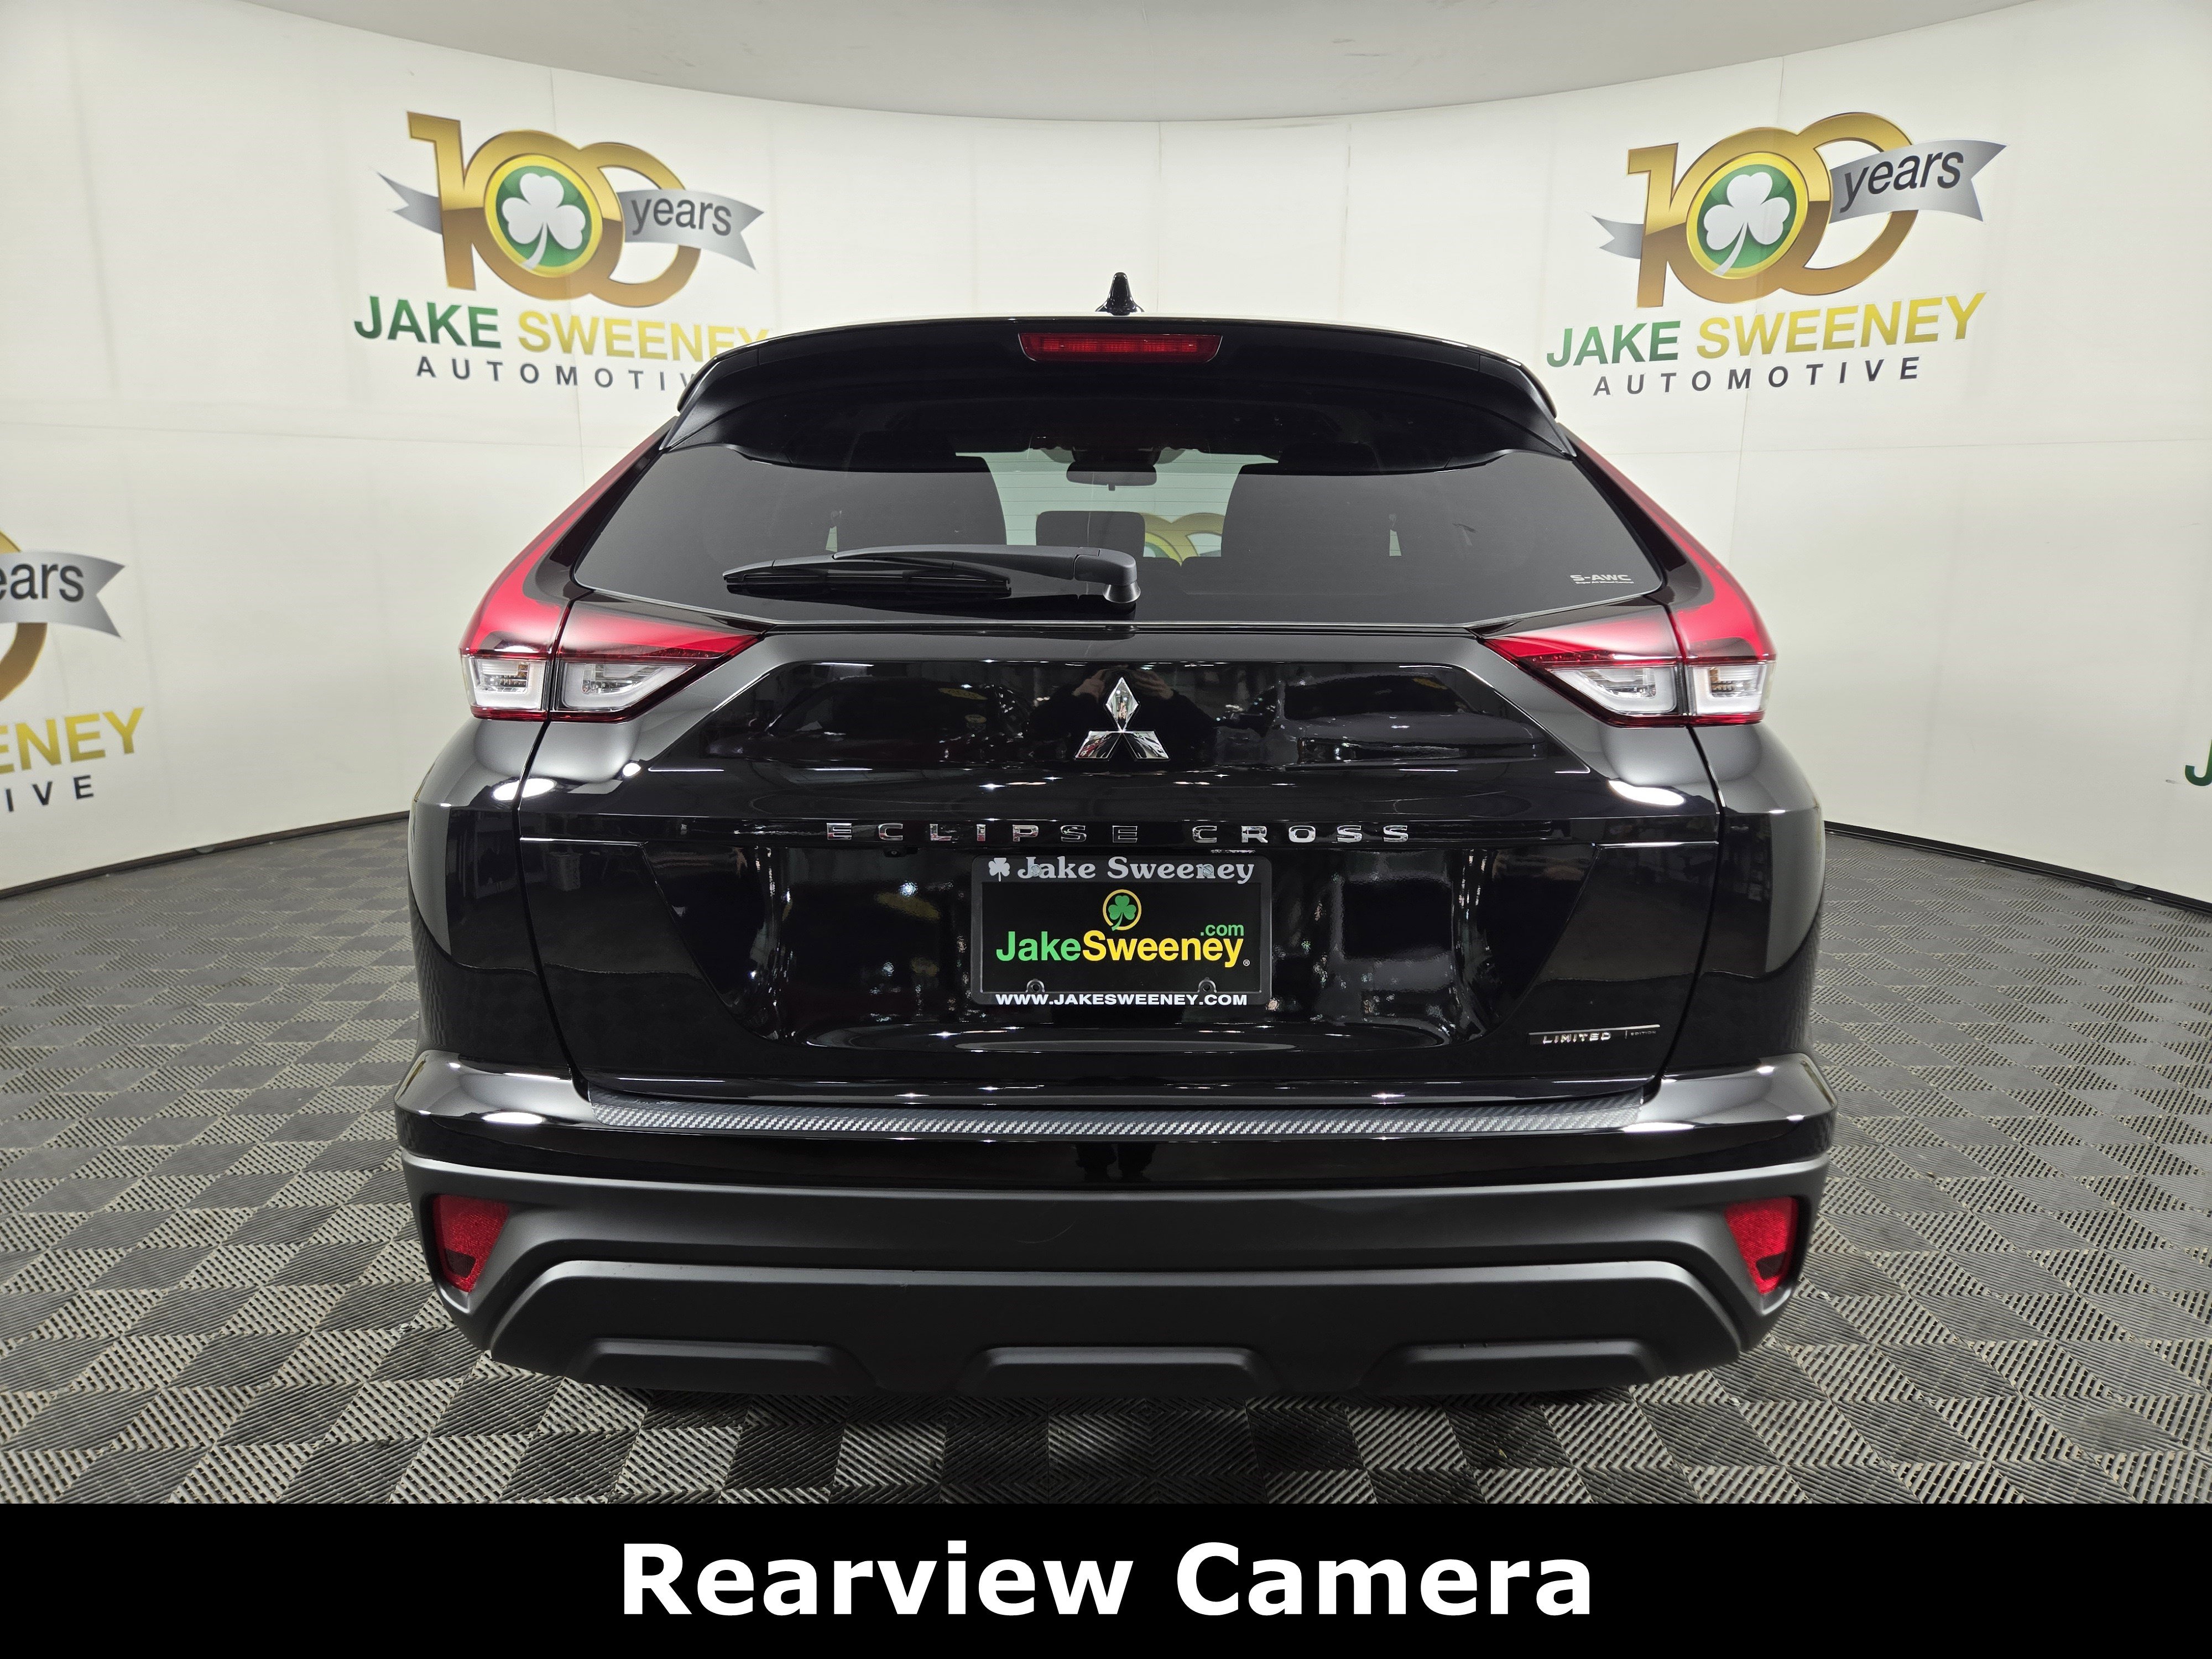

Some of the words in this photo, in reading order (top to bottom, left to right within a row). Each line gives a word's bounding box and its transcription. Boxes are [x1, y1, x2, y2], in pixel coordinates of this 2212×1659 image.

[1839, 151, 1964, 214] years
[631, 197, 732, 236] years
[354, 295, 502, 349] JAKE
[1547, 320, 1681, 368] JAKE
[1696, 291, 1986, 359] SWEENEY
[1593, 356, 1920, 397] AUTOMOTIVE
[826, 823, 1138, 843] ECLIPSE
[1192, 825, 1408, 843] CROSS
[1018, 856, 1096, 879] Jake
[1108, 856, 1255, 884] Sweeney
[995, 994, 1248, 1005] WWW.JAKESWEENEY.COM
[1542, 1032, 1611, 1044] LIMITED
